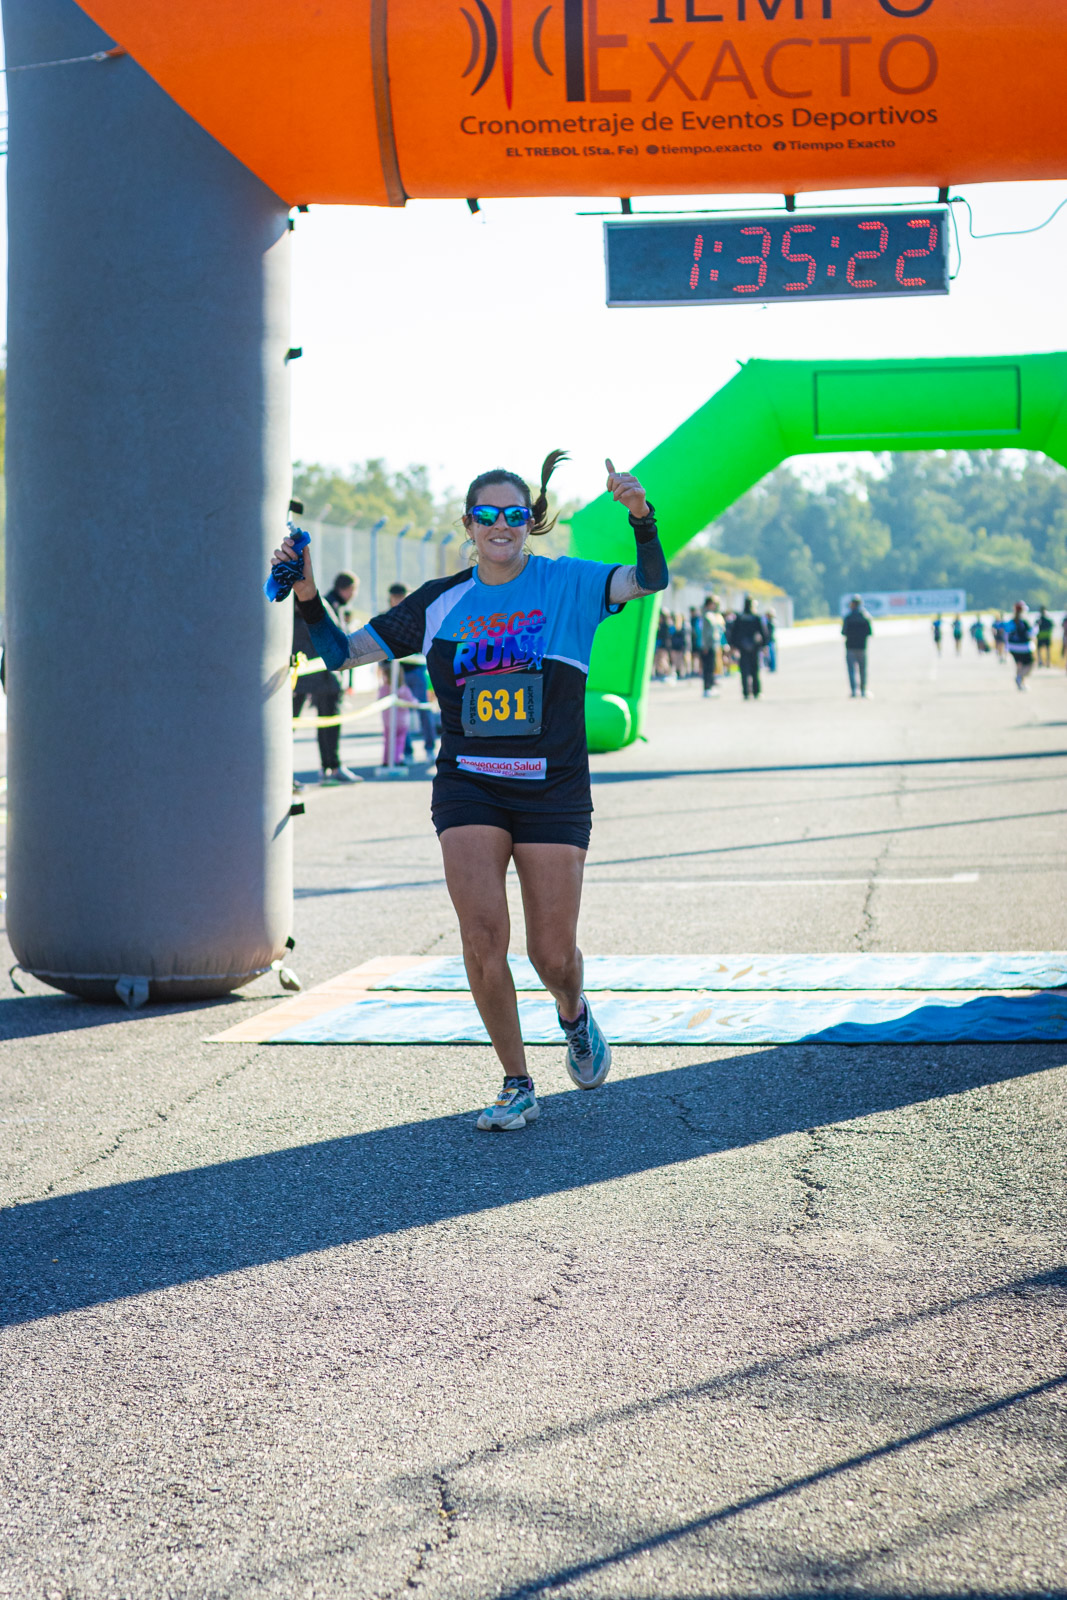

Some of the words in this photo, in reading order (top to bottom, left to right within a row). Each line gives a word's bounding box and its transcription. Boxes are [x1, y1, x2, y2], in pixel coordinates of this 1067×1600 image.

[460, 113, 634, 137] Cronometraje
[642, 111, 674, 131] de
[681, 109, 784, 130] Eventos
[792, 106, 938, 130] Deportivos
[506, 147, 522, 157] EL
[525, 146, 580, 156] TREBOL
[617, 145, 639, 156] Fe)
[661, 142, 763, 155] tiempo.exacto
[788, 140, 844, 152] Tiempo
[847, 138, 896, 149] Exacto
[689, 218, 938, 293] 1:35:22
[477, 688, 527, 722] 631
[527, 685, 535, 724] EXACTO
[513, 761, 541, 771] Salud
